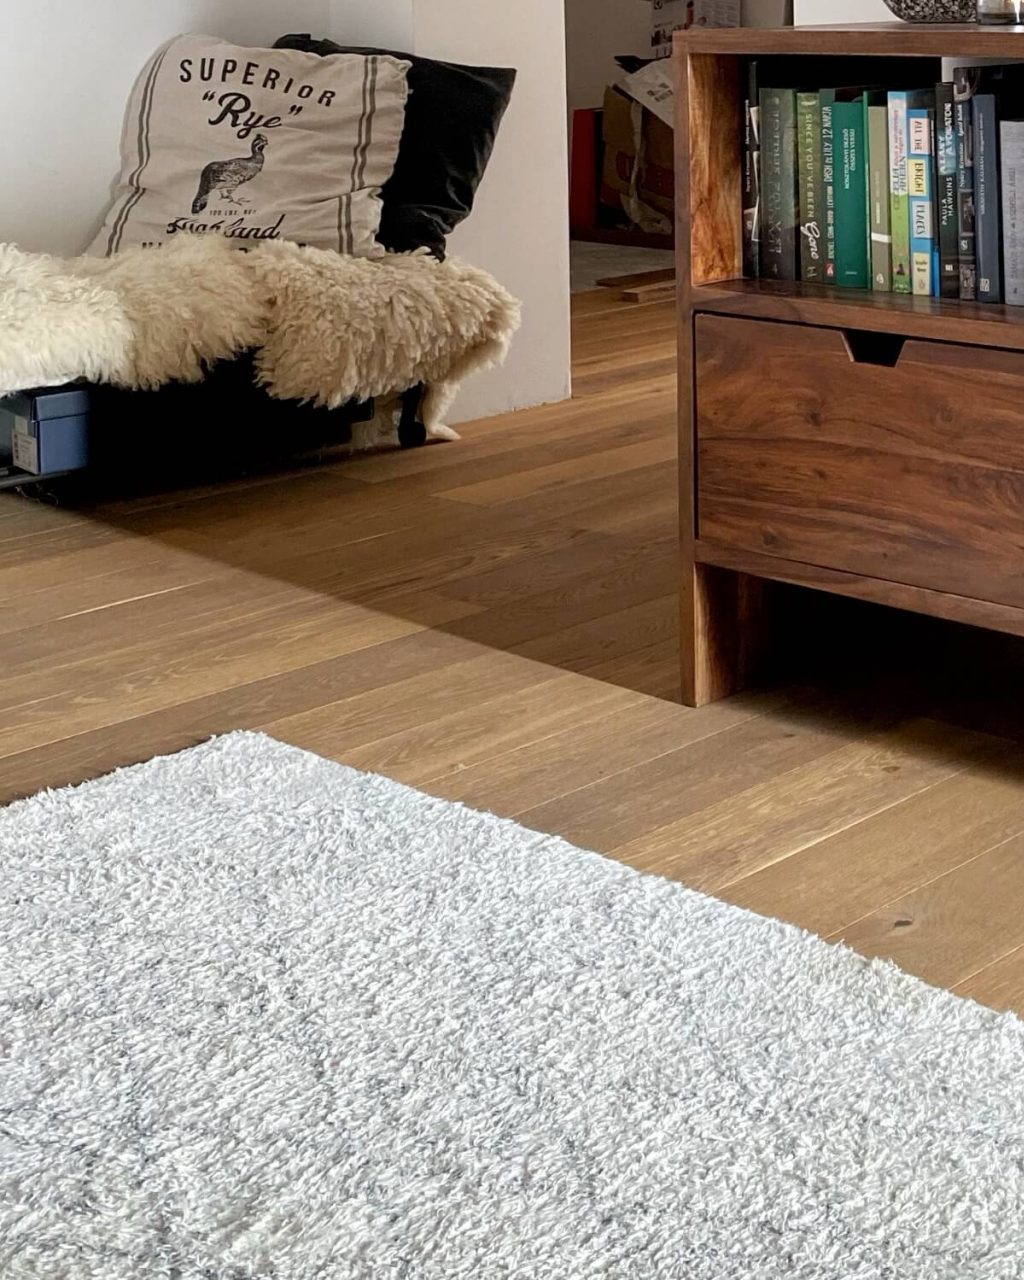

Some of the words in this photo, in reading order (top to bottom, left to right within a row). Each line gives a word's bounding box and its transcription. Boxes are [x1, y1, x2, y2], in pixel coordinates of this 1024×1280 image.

[179, 57, 336, 107] SUPERIOR
[805, 113, 813, 144] SINCE
[821, 106, 832, 128] NAPJA
[914, 120, 923, 133] ALL
[943, 102, 953, 147] VONATON
[822, 128, 832, 139] 12
[848, 128, 856, 149] VERSEI
[914, 139, 923, 151] THE
[822, 142, 832, 156] LILY
[848, 149, 856, 171] ÖSSZES
[938, 135, 946, 165] LÁNY
[823, 164, 833, 182] DASH
[842, 148, 850, 189] KOSZTOLÁNYI
[899, 156, 907, 192] AHERN
[914, 162, 924, 193] BRIGHT
[806, 191, 815, 218] BEEN
[946, 176, 954, 217] HAWKINS
[915, 204, 925, 235] PLACES
[801, 221, 820, 259] Gone
